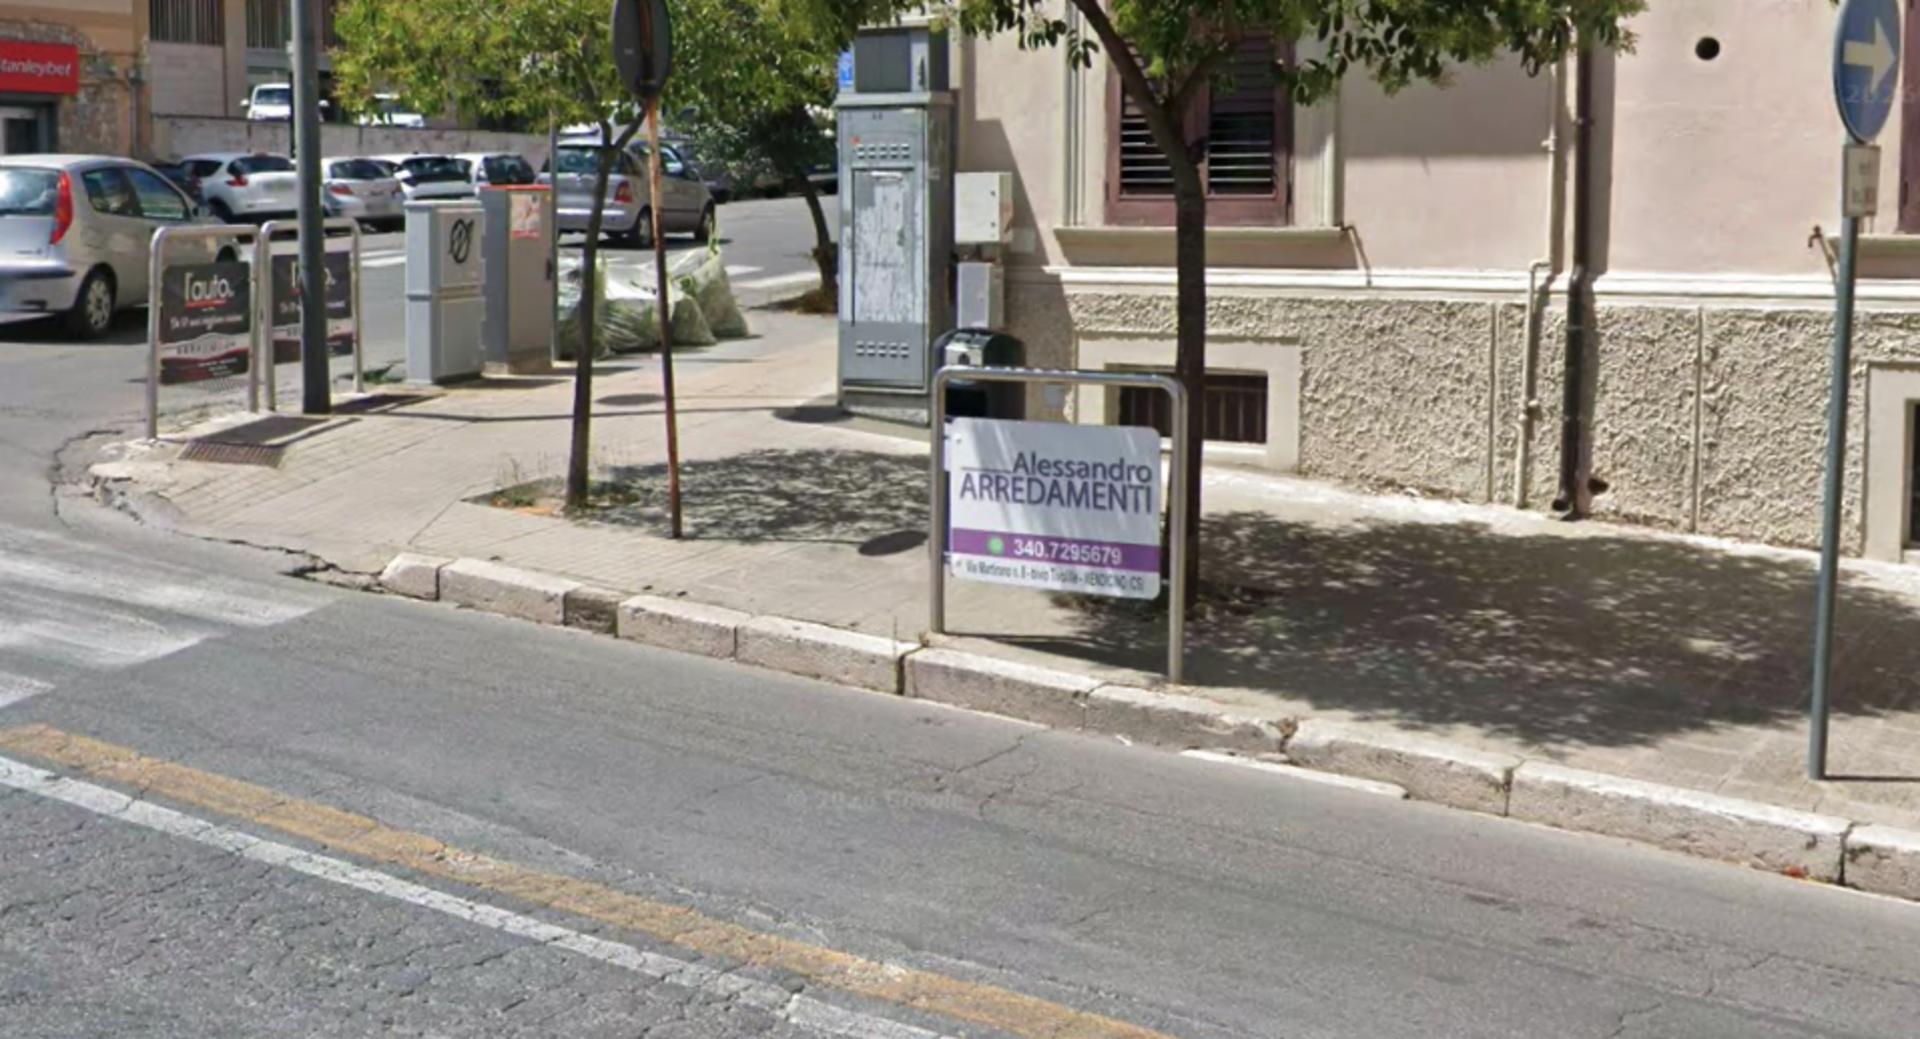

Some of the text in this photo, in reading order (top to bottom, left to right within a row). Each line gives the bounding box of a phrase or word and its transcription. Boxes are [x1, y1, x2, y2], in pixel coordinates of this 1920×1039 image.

[0, 58, 72, 77] tanleybet
[1012, 451, 1153, 484] Alessandro
[959, 472, 1153, 515] ARREDAMENTI
[1013, 538, 1123, 566] 340.7295679
